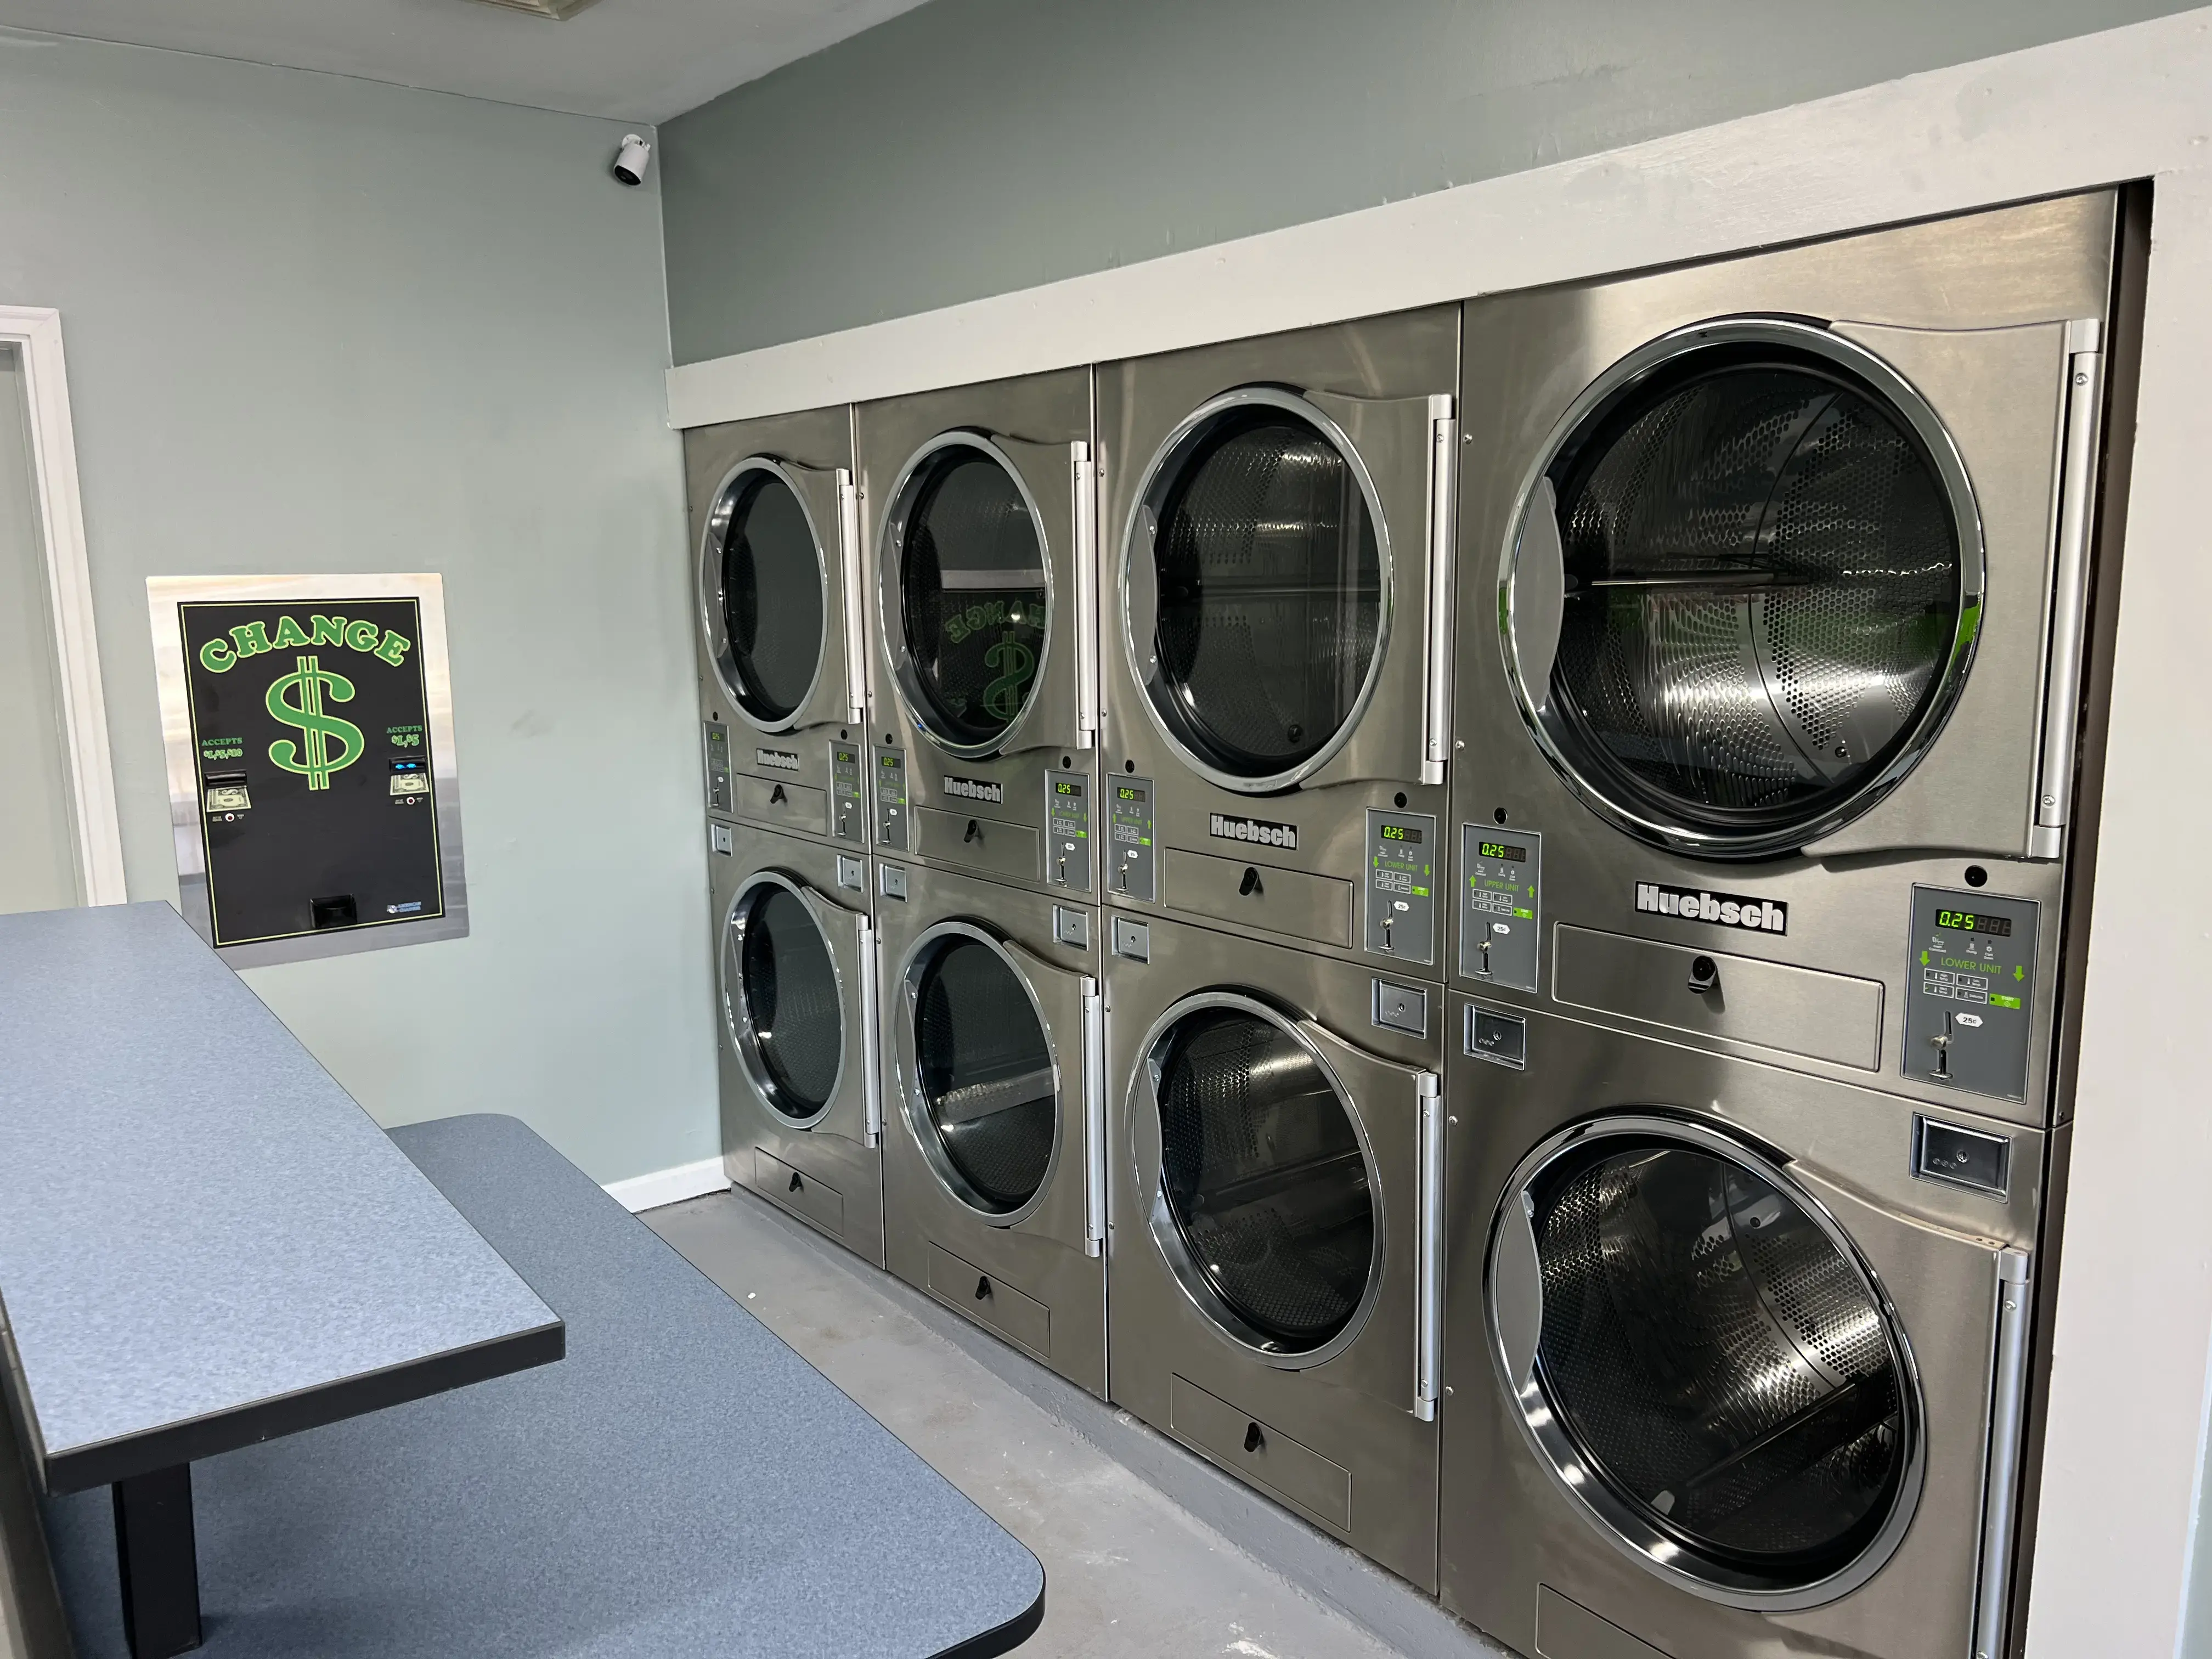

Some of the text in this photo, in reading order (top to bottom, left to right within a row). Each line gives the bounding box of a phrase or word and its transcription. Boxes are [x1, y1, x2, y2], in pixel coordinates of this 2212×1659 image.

[200, 615, 411, 673] CHANGE
[266, 656, 364, 791] $
[387, 725, 422, 733] ACCEPTS
[202, 737, 242, 746] ACCEPTS
[391, 734, 419, 748] $1,$5
[204, 748, 242, 760] $1,$5,$10
[757, 749, 798, 769] Huebsch
[944, 777, 1000, 802] Huebsch
[1211, 815, 1295, 848] Huebsch
[1384, 827, 1403, 839] 0.25
[1482, 844, 1504, 857] 0.25
[1385, 860, 1404, 870] LOWER
[1485, 879, 1519, 892] UPPER UNIT
[1637, 884, 1784, 931] Huebsch
[1939, 911, 1974, 929] 0.25
[1941, 957, 2002, 975] LOWER UNIT
